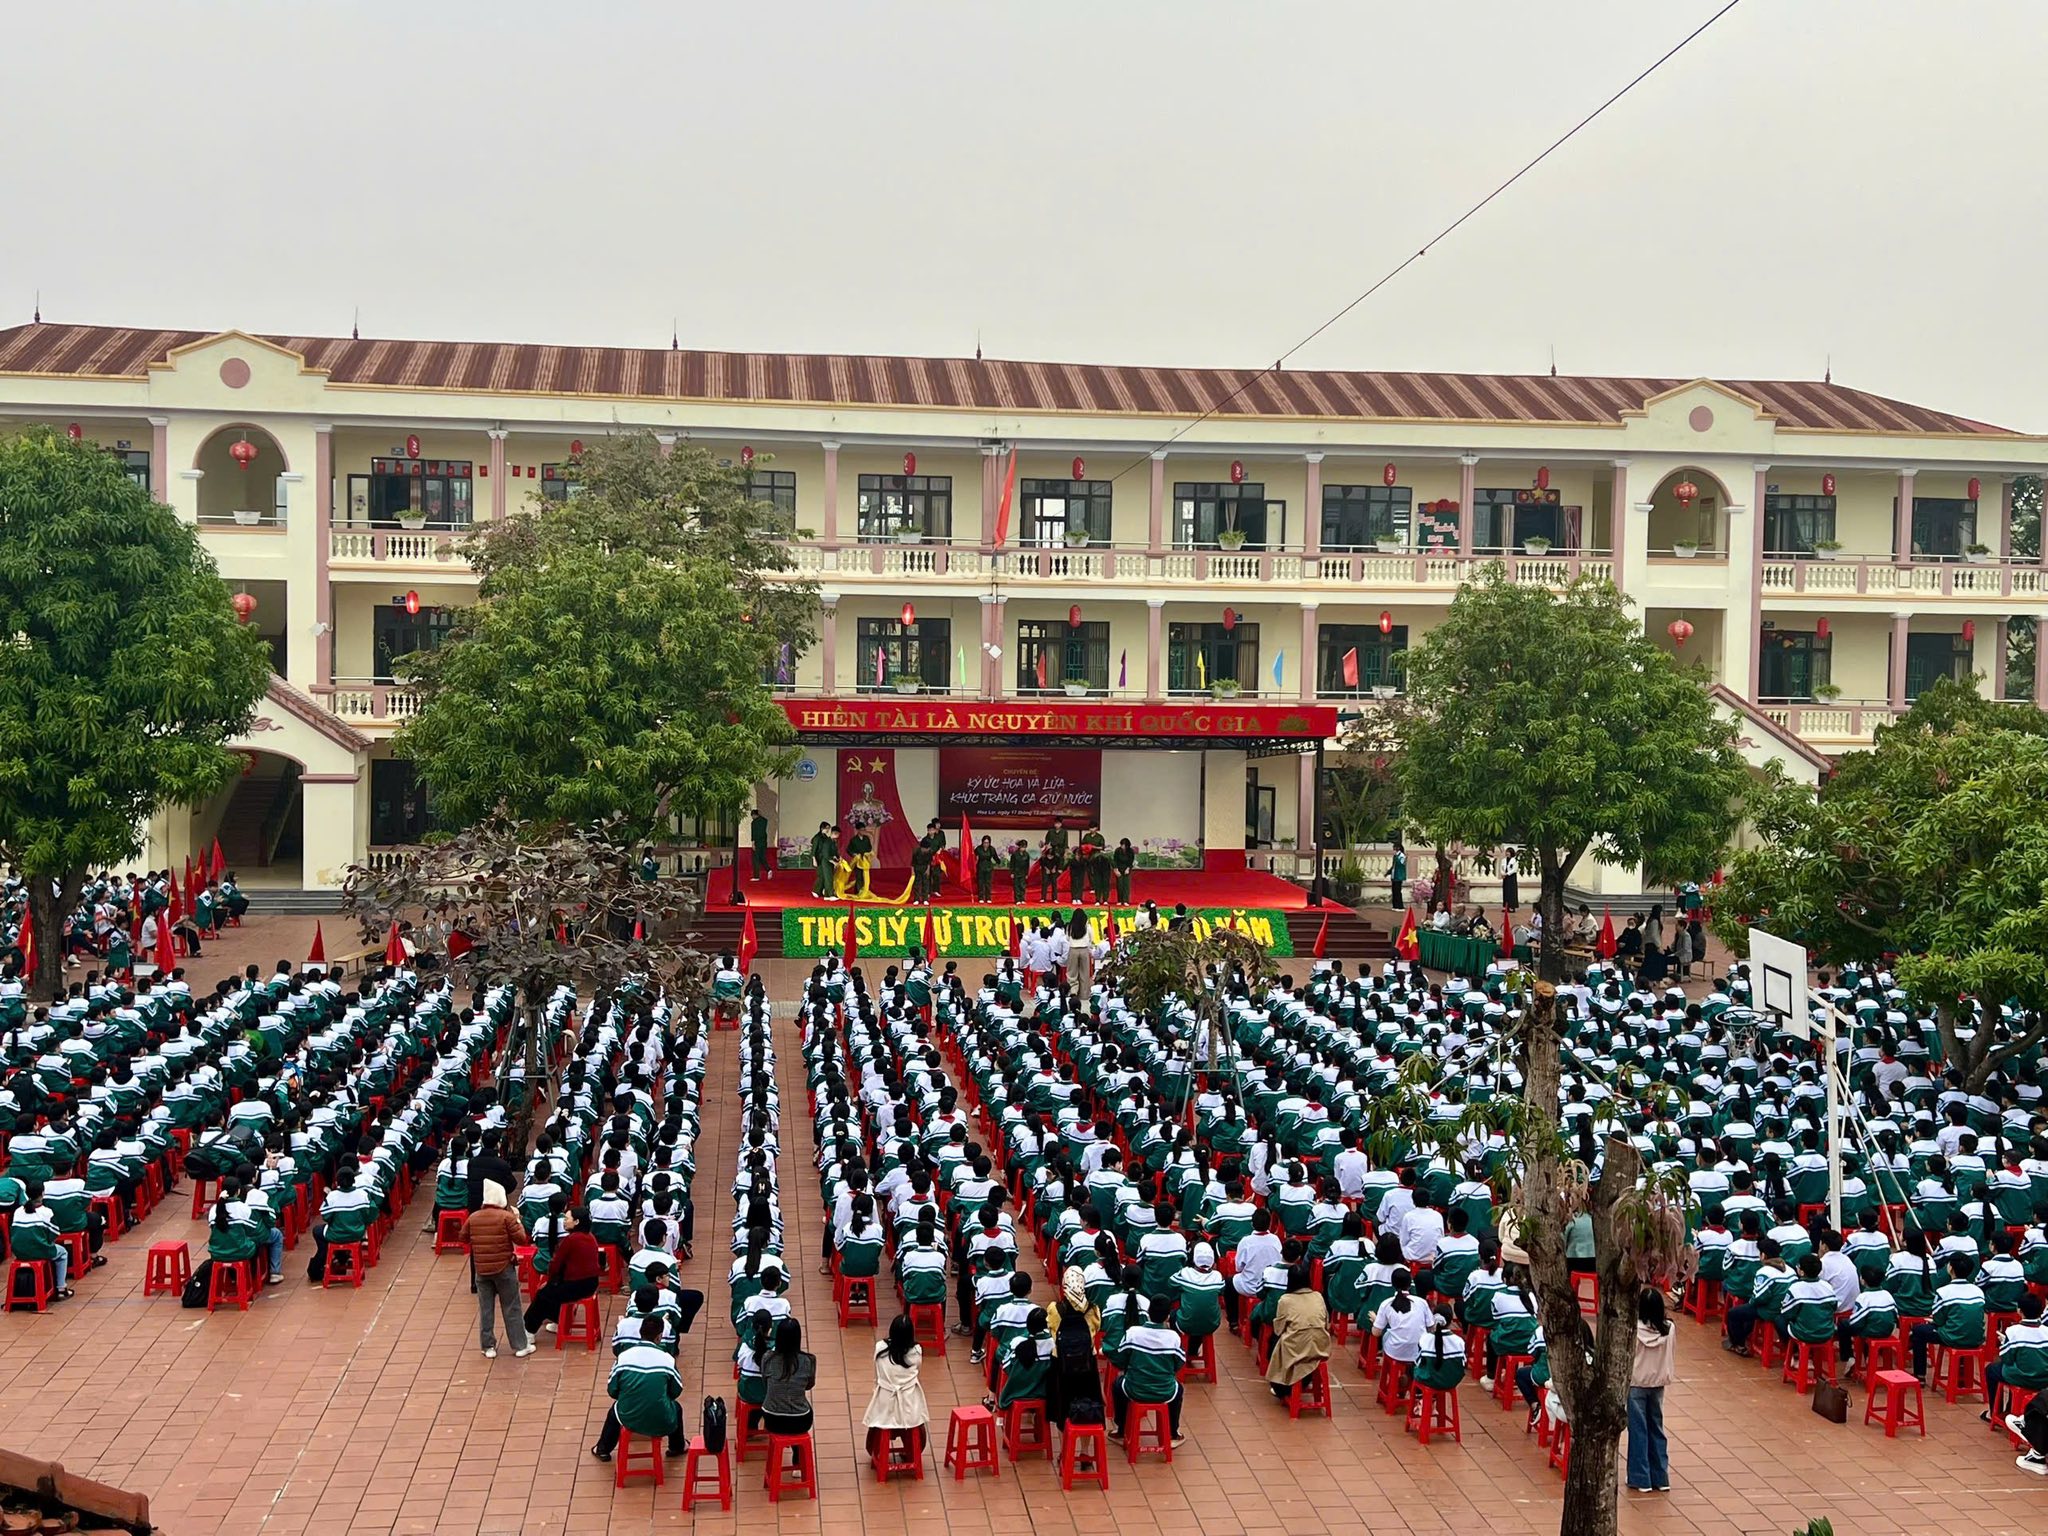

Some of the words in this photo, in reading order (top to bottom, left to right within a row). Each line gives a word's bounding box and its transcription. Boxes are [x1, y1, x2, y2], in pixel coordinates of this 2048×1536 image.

[801, 705, 867, 728] HIỀN
[875, 708, 919, 729] TÀI
[926, 708, 960, 730] LÀ
[968, 710, 1077, 731] NGUYÊN
[1085, 711, 1133, 731] KHÍ
[1140, 711, 1211, 732] QUỐC
[1217, 716, 1262, 732] GIA
[1002, 778, 1023, 789] HOA
[950, 790, 980, 803] KHÚC
[1022, 793, 1036, 804] CA
[879, 908, 909, 946] LÝ
[956, 915, 1052, 950] TRỌ
